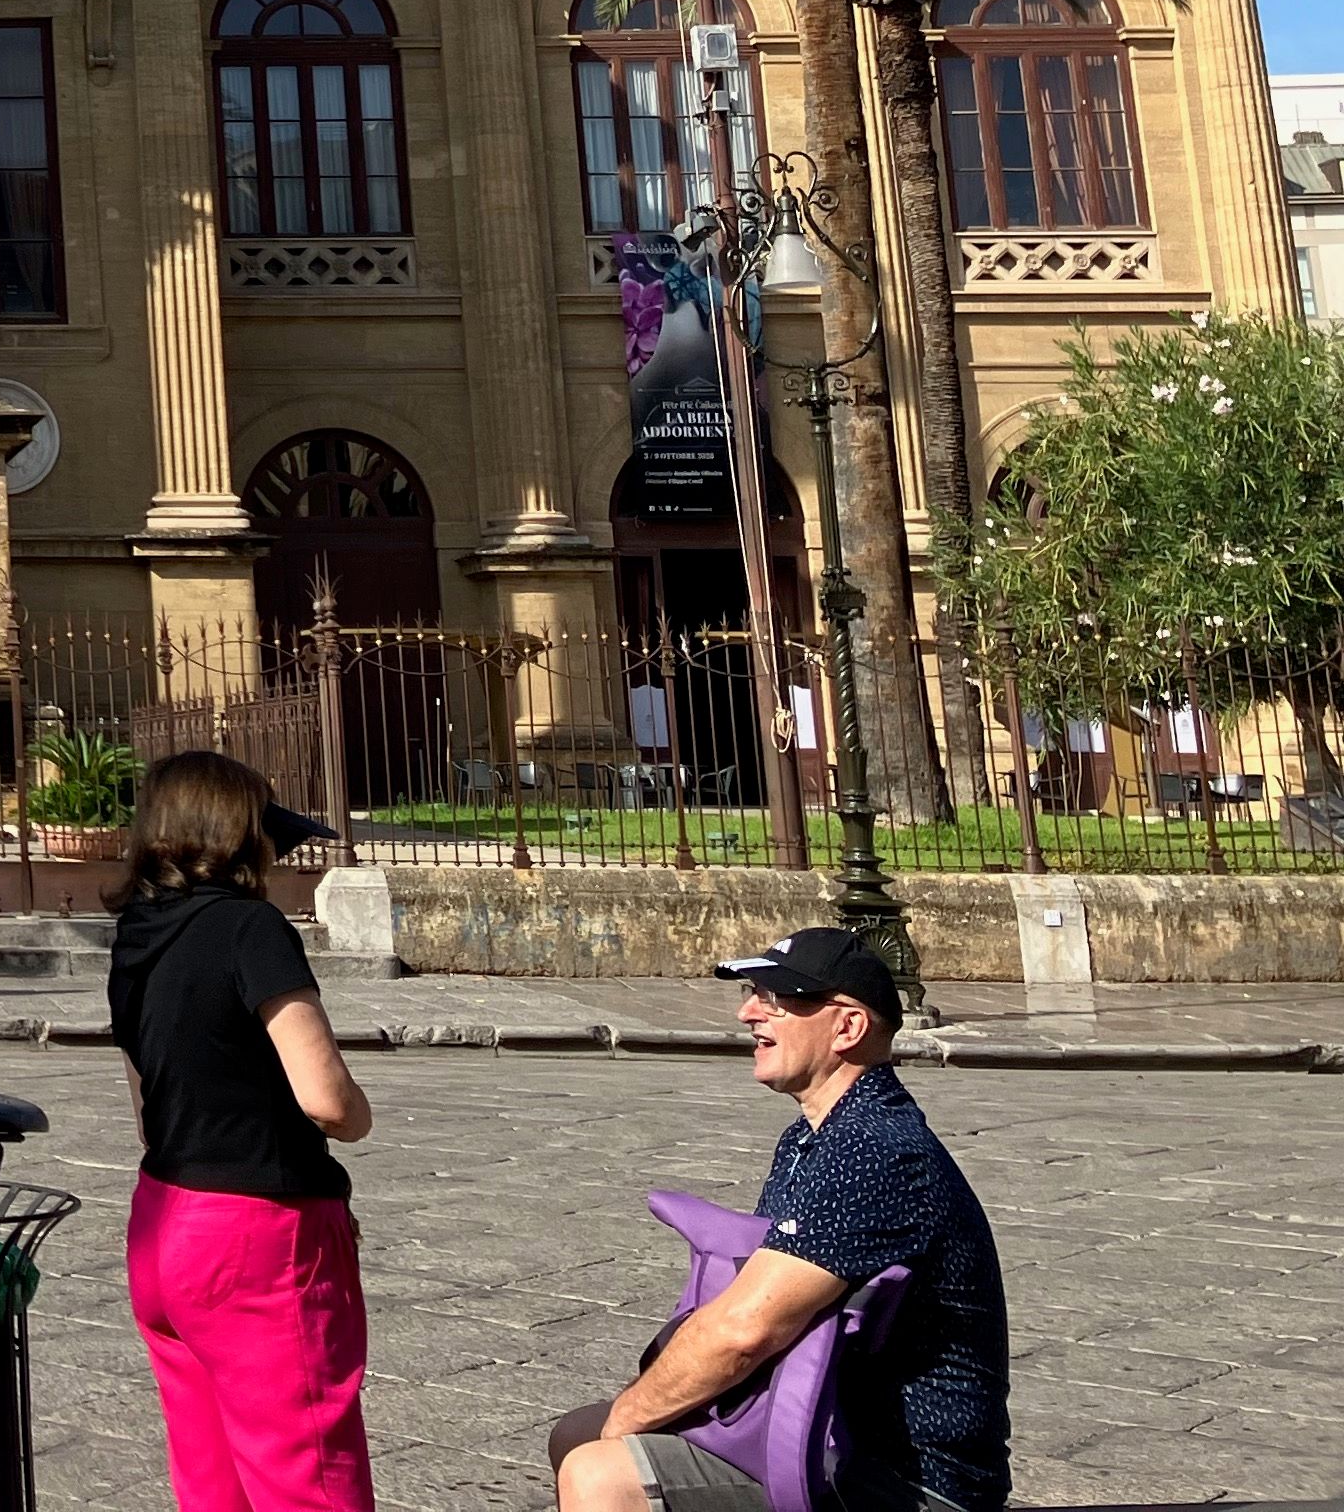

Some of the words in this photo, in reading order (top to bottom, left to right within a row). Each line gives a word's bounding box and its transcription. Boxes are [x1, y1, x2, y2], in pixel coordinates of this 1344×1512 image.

[666, 412, 684, 424] LA
[687, 412, 731, 424] BELLA
[642, 426, 736, 437] ADDORMENT
